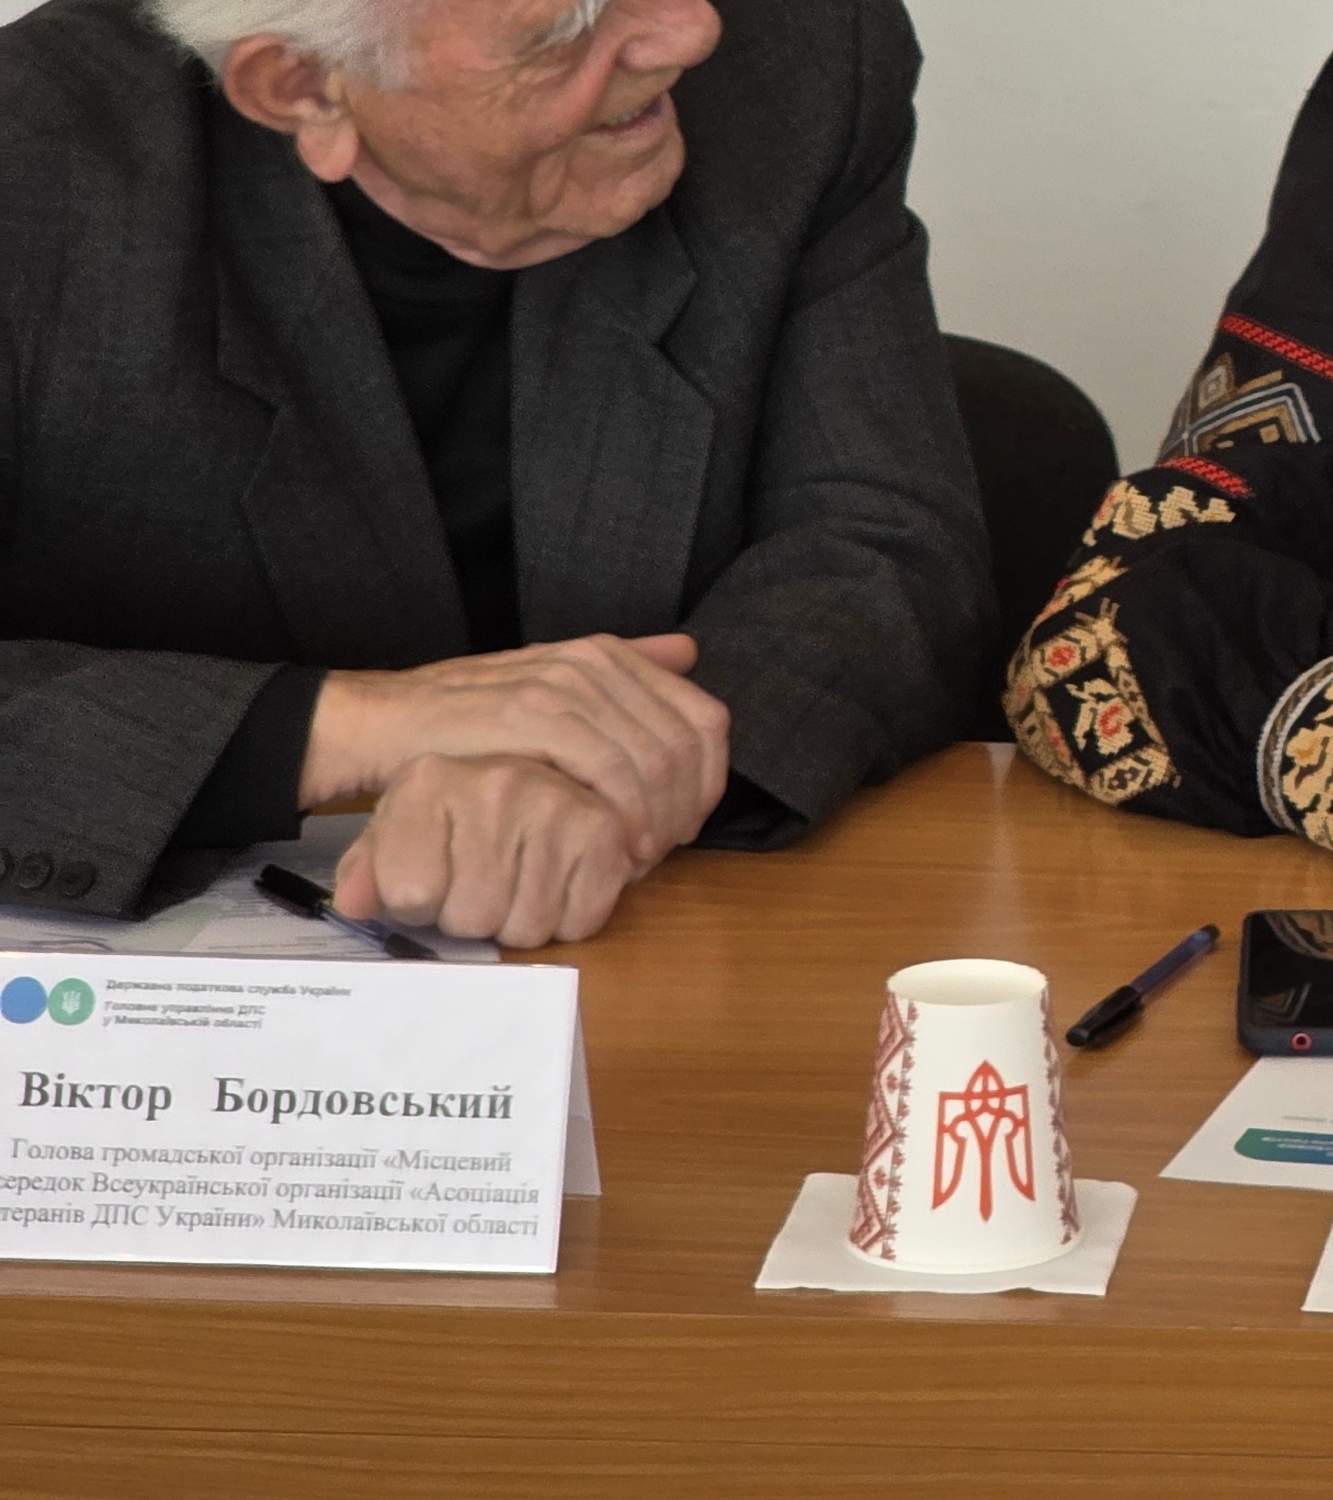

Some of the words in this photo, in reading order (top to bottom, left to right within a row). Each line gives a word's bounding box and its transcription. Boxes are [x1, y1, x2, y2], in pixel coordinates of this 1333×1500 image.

[19, 1071, 173, 1121] Віктор
[212, 1077, 513, 1123] Бордовський
[11, 1139, 94, 1163] Голова
[102, 1146, 244, 1168] громадської
[249, 1148, 377, 1170] організації
[92, 1173, 268, 1198] Всеукраїнської
[275, 1180, 403, 1202] організації
[92, 1204, 149, 1228] ДПС
[273, 1209, 447, 1234] Миколаївської
[453, 1211, 539, 1236] області
